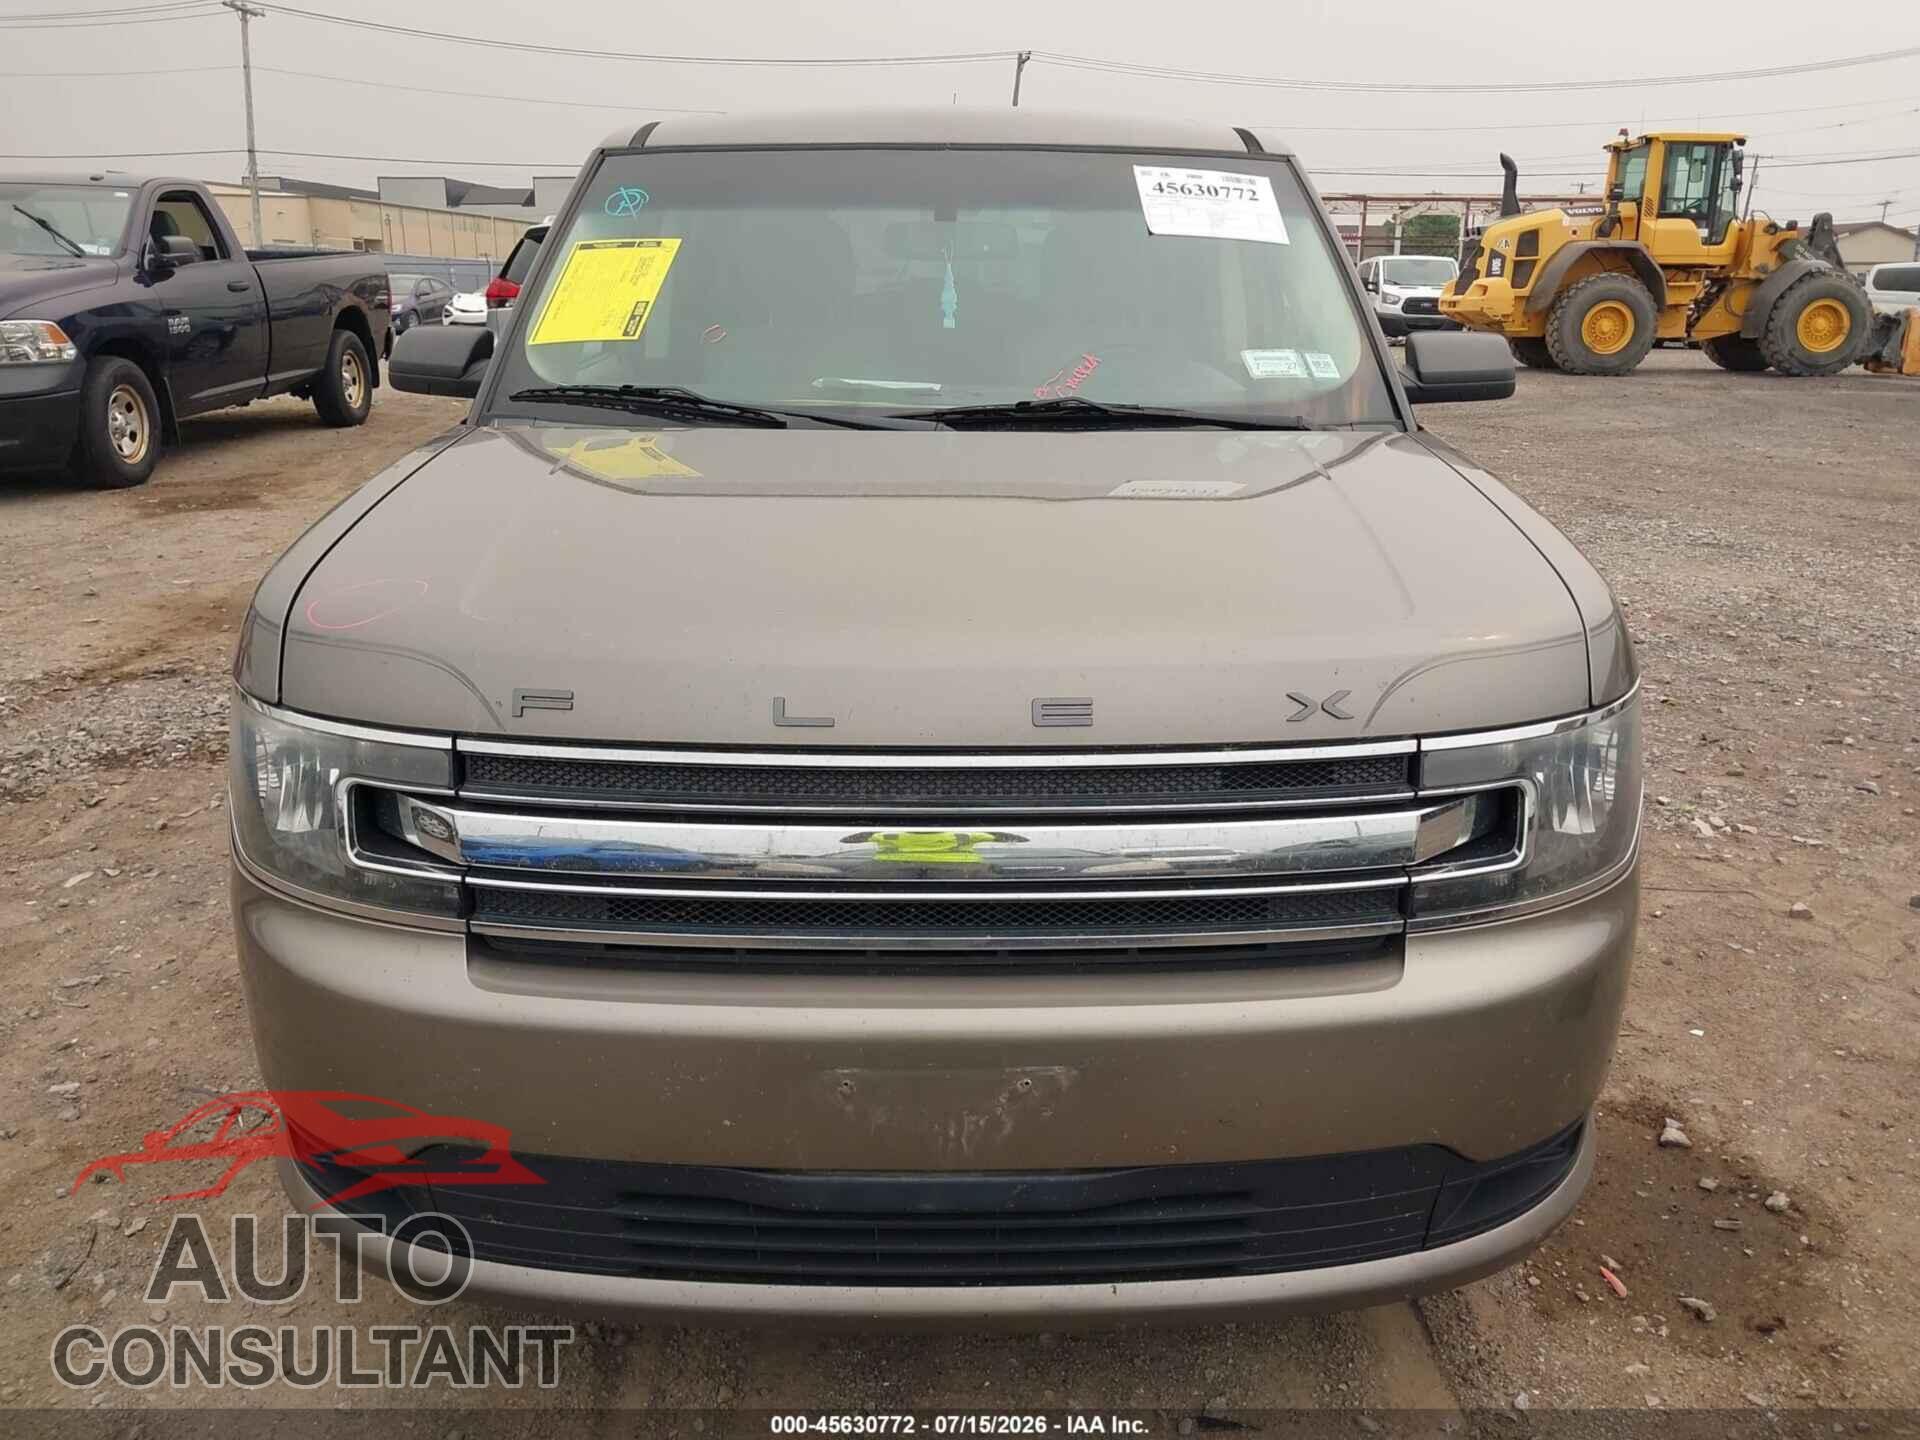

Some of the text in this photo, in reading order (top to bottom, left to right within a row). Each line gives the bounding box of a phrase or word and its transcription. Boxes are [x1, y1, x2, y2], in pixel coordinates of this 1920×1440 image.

[1152, 181, 1259, 202] 45630772
[1567, 207, 1603, 215] VOLVO
[511, 687, 1354, 727] FLEX
